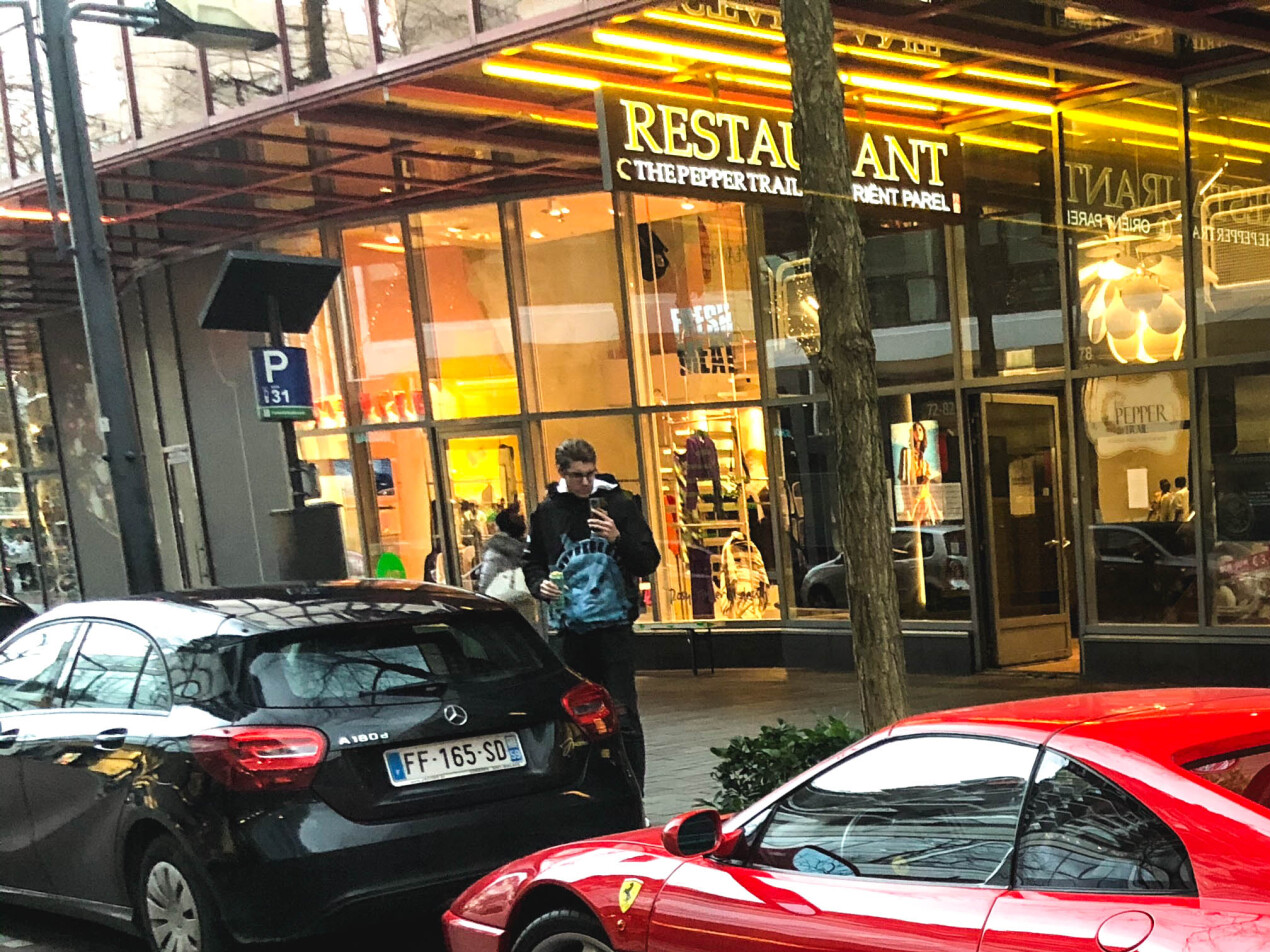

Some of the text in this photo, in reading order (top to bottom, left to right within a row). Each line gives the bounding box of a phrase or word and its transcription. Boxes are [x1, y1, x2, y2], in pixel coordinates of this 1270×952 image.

[620, 98, 948, 187] RESTAUANT
[633, 159, 951, 213] THE PEPPER TRAIL RIËNT PAREL
[263, 350, 289, 384] P
[271, 389, 290, 404] 31
[1115, 403, 1168, 425] PEPPER
[403, 739, 508, 775] FF-165-SD
